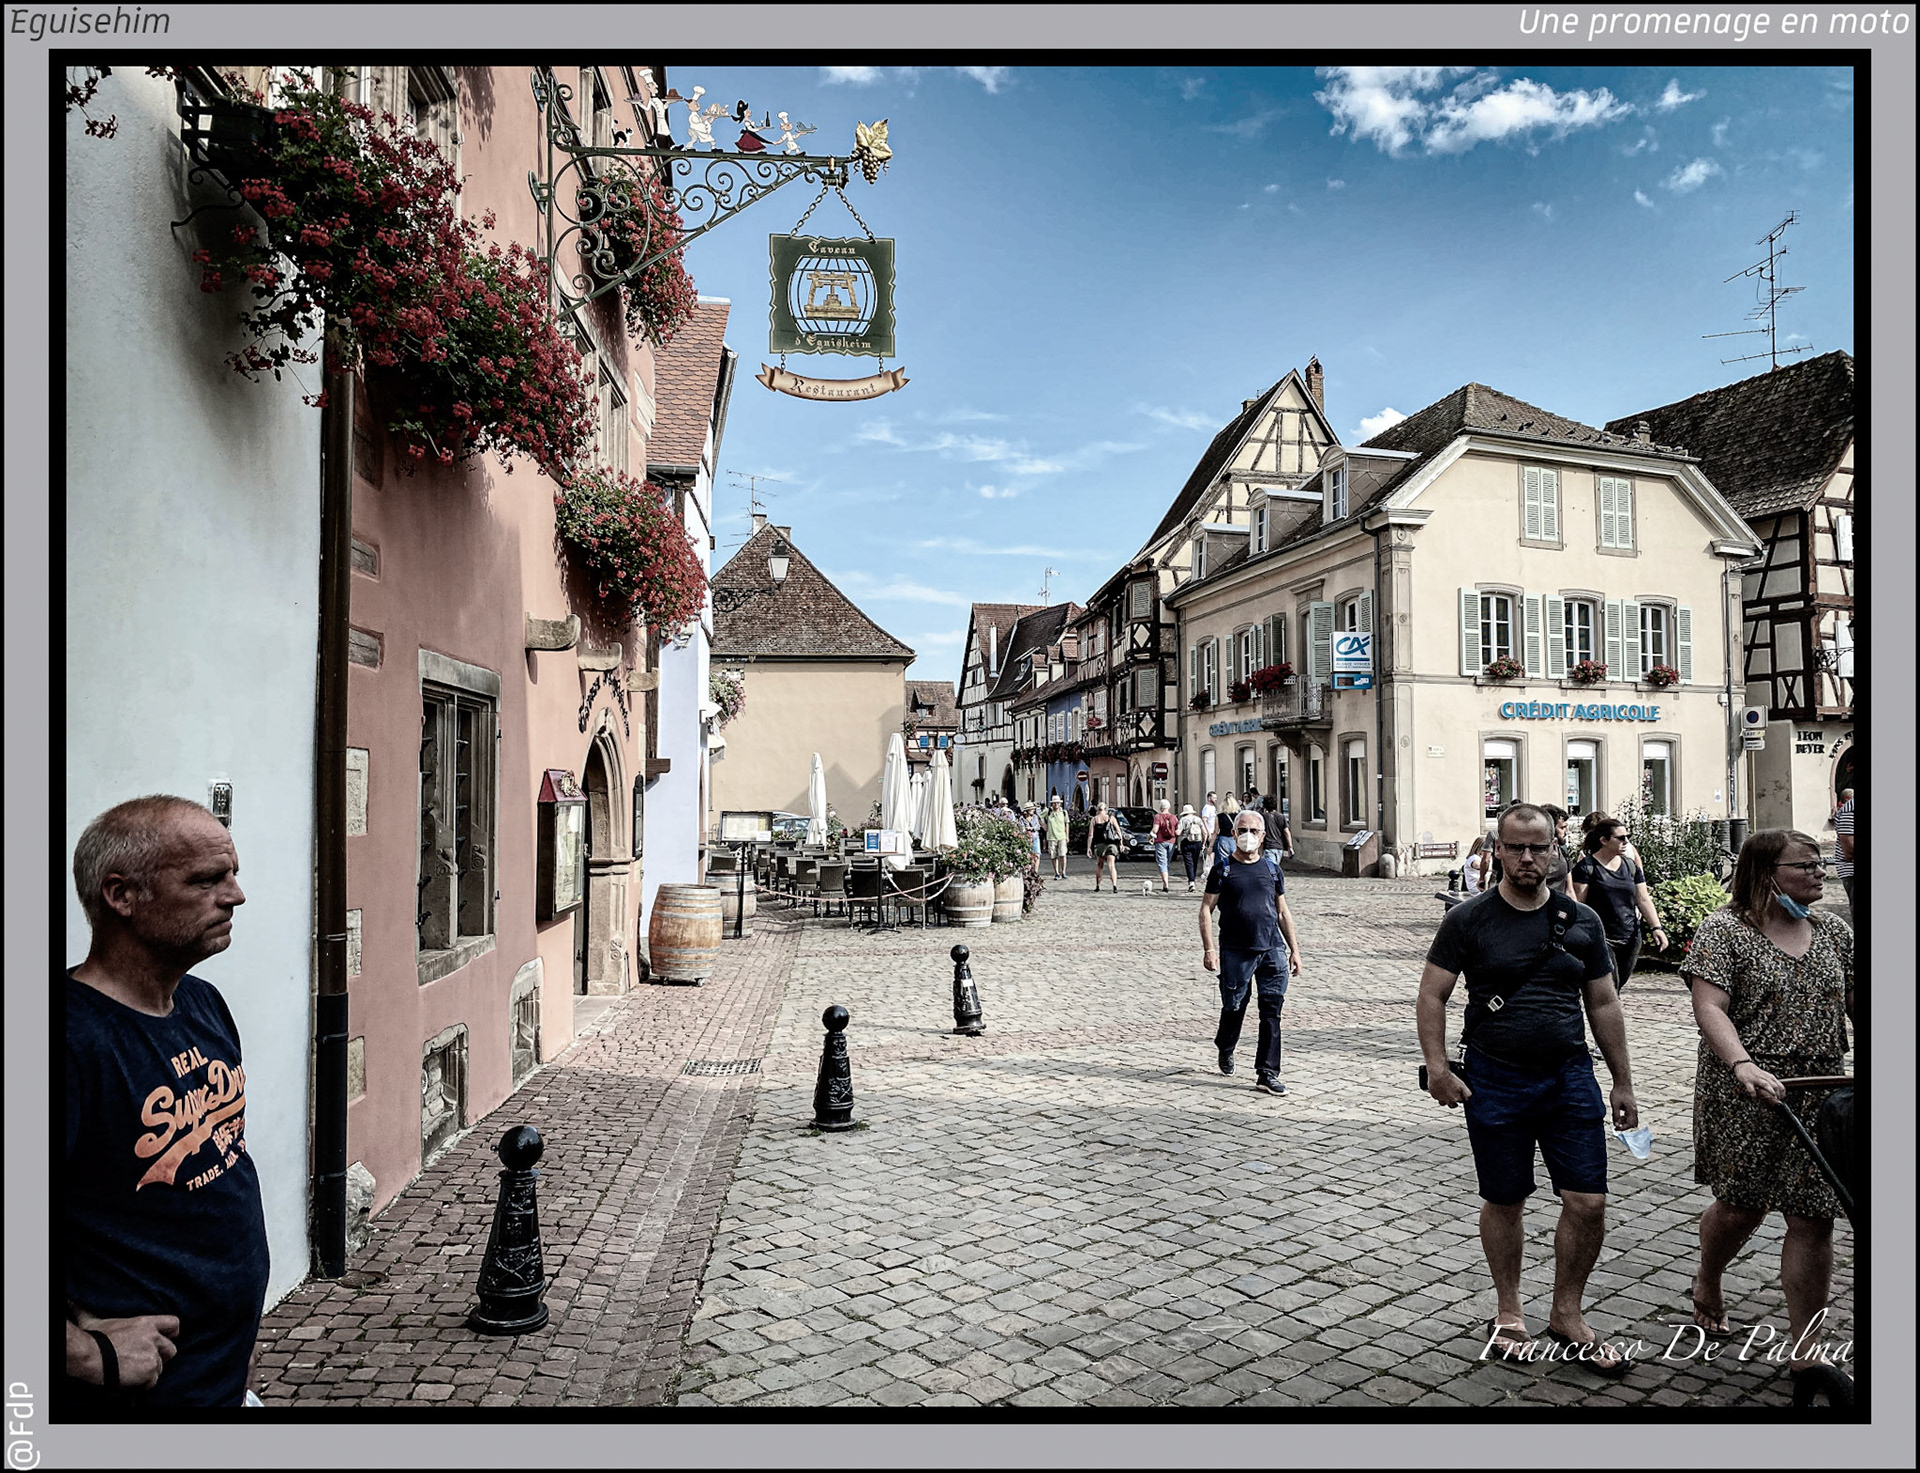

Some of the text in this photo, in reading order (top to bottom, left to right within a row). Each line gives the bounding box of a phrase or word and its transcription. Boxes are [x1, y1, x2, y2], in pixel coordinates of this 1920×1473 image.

[808, 240, 856, 254] Caveau
[789, 377, 878, 398] Restaurant
[1501, 700, 1661, 720] CRÉDIT AGRICOLE
[1795, 743, 1825, 754] BEYER
[171, 1046, 209, 1078] REAL
[186, 1164, 224, 1192] TRADE.
